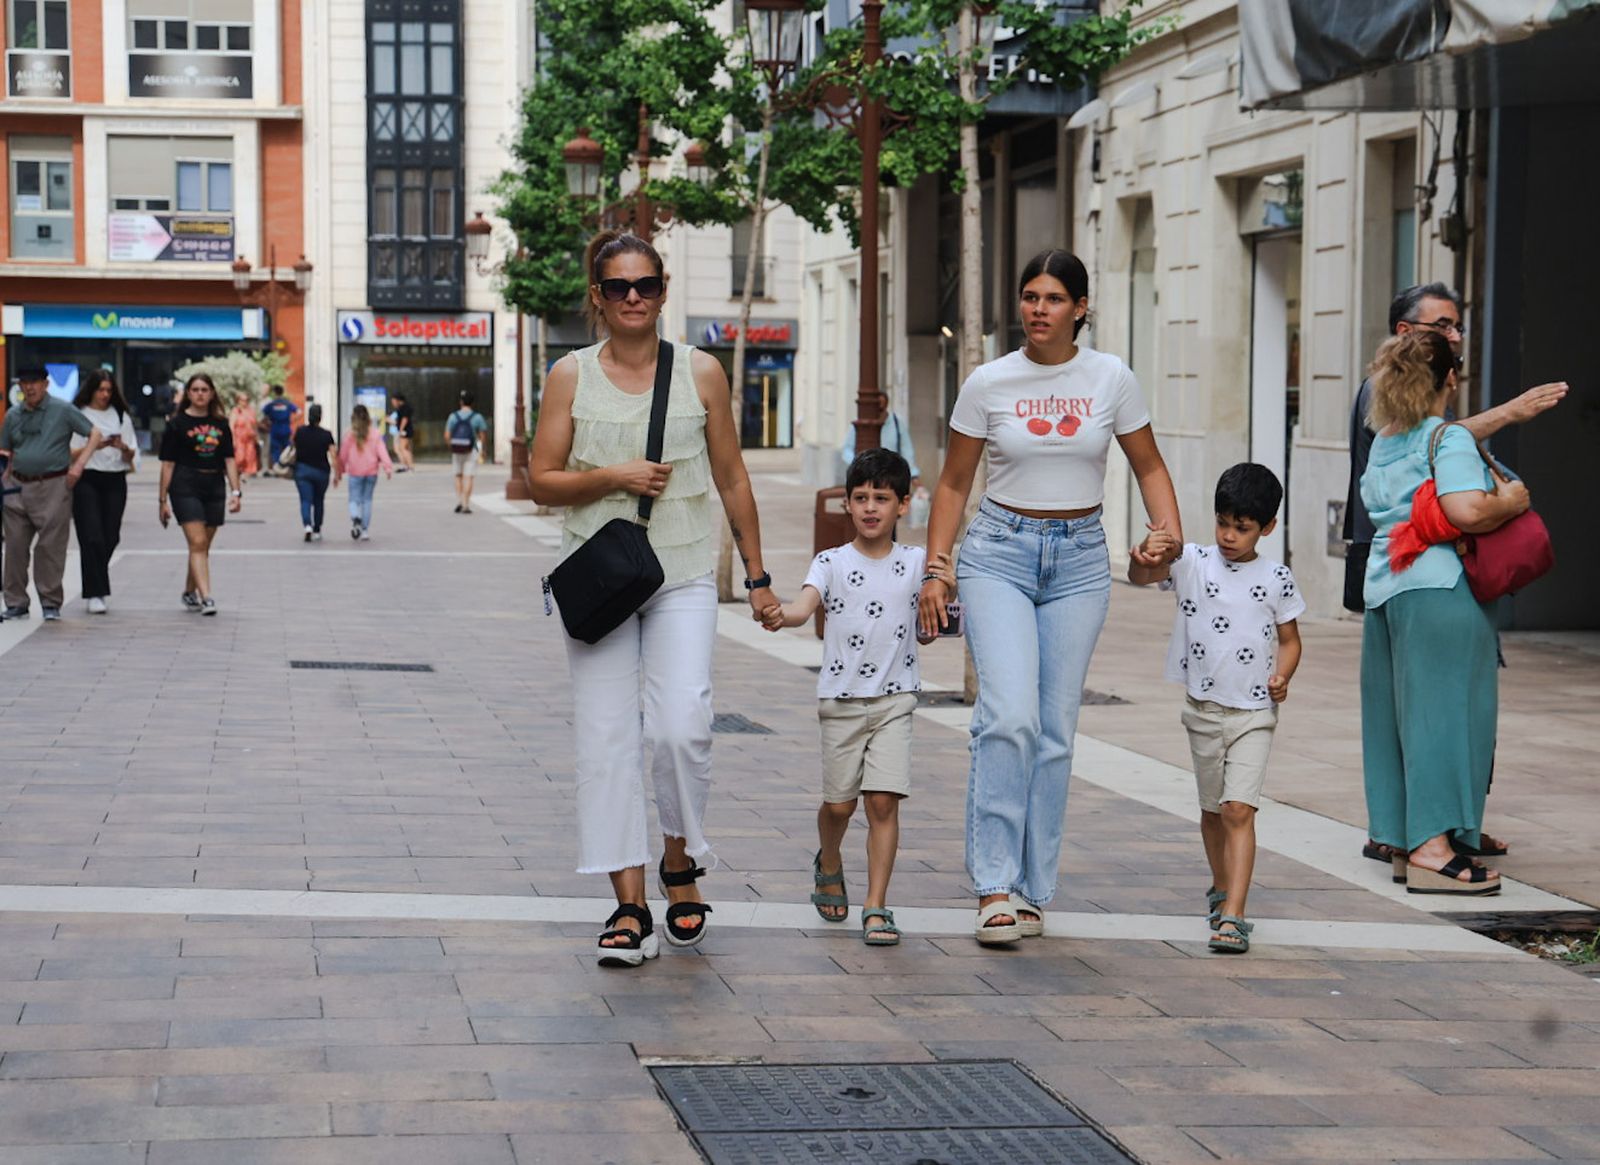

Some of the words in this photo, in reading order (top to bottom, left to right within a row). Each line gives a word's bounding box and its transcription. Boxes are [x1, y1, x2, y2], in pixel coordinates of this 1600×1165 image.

[119, 316, 175, 329] movistar
[373, 315, 487, 340] Soloptical
[722, 321, 791, 343] Sooptical
[1015, 397, 1093, 418] CHERRY
